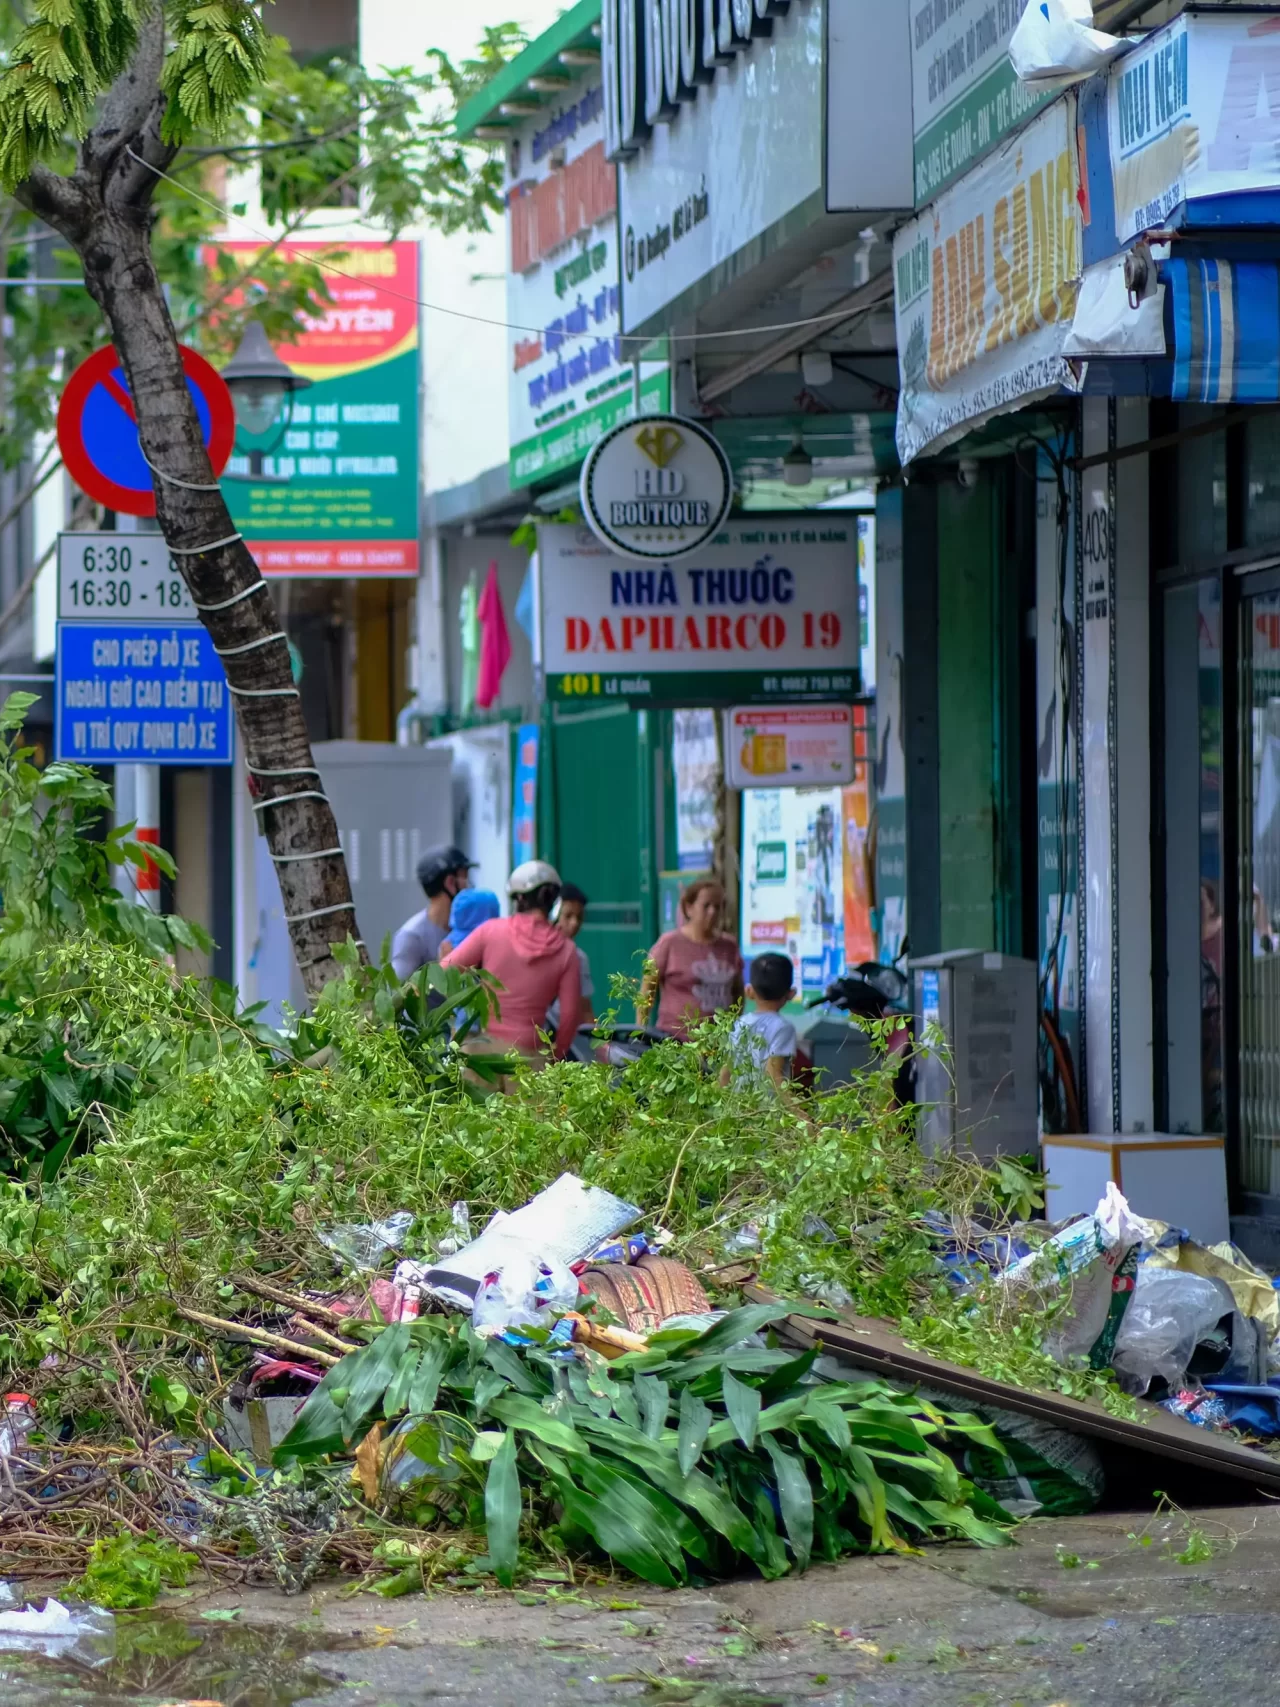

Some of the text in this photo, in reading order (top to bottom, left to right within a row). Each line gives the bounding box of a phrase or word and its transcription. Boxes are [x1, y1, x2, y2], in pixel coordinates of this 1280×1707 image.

[634, 468, 685, 498] HD
[610, 501, 710, 530] BOUTIQUE
[1083, 507, 1109, 565] 403
[83, 546, 132, 572] 6:30
[69, 581, 132, 606] 16:30
[156, 580, 190, 606] 18:
[610, 554, 794, 606] NHÀ THUỐC
[565, 611, 841, 654] DAPHARCO 19
[92, 639, 119, 667] CHO
[123, 633, 158, 667] PHÉP
[182, 639, 200, 667] XE
[65, 668, 223, 713] NGOÀI GIỜ CAO ĐIỂM TẠI
[557, 673, 600, 695] 401
[73, 721, 87, 755] VỊ
[89, 716, 111, 749] TRÍ
[114, 721, 141, 752] QUY
[143, 721, 175, 755] ĐỊNH
[199, 721, 217, 749] XE
